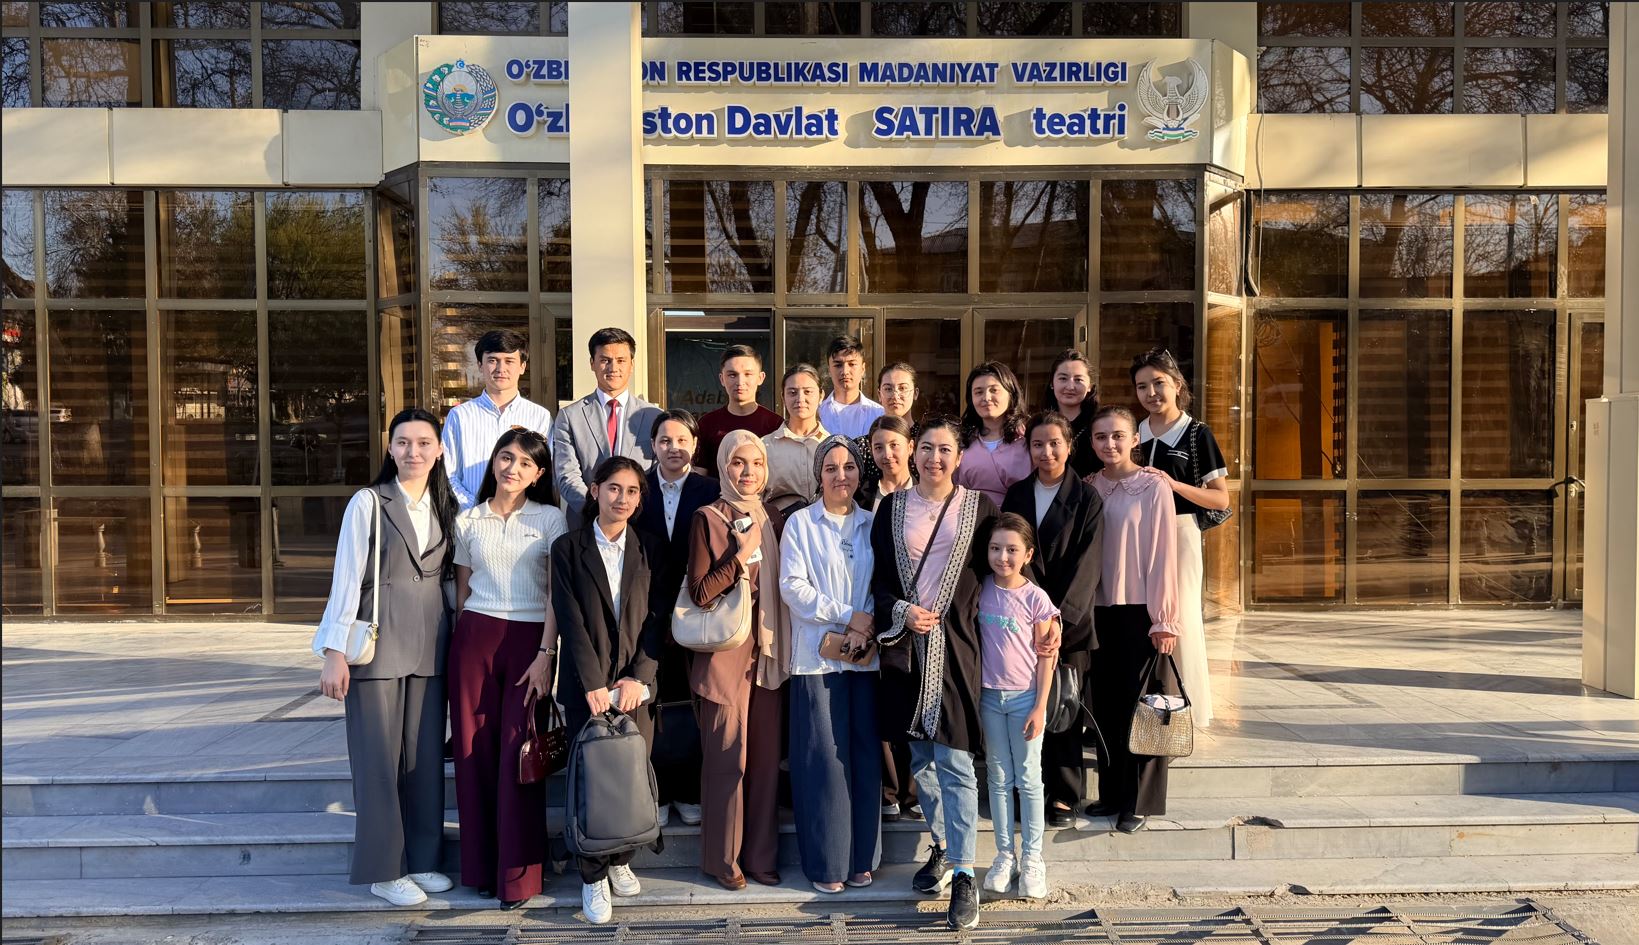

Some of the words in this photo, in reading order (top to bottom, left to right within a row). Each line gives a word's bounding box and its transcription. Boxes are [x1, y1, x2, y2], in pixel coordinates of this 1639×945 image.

[676, 61, 849, 83] RESPUBLIKASI
[859, 61, 998, 83] MADANIYAT
[1011, 61, 1128, 83] VAZIRLIGI
[726, 105, 839, 137] Davlat
[875, 106, 1001, 137] SATIRA
[1033, 103, 1127, 136] teatri
